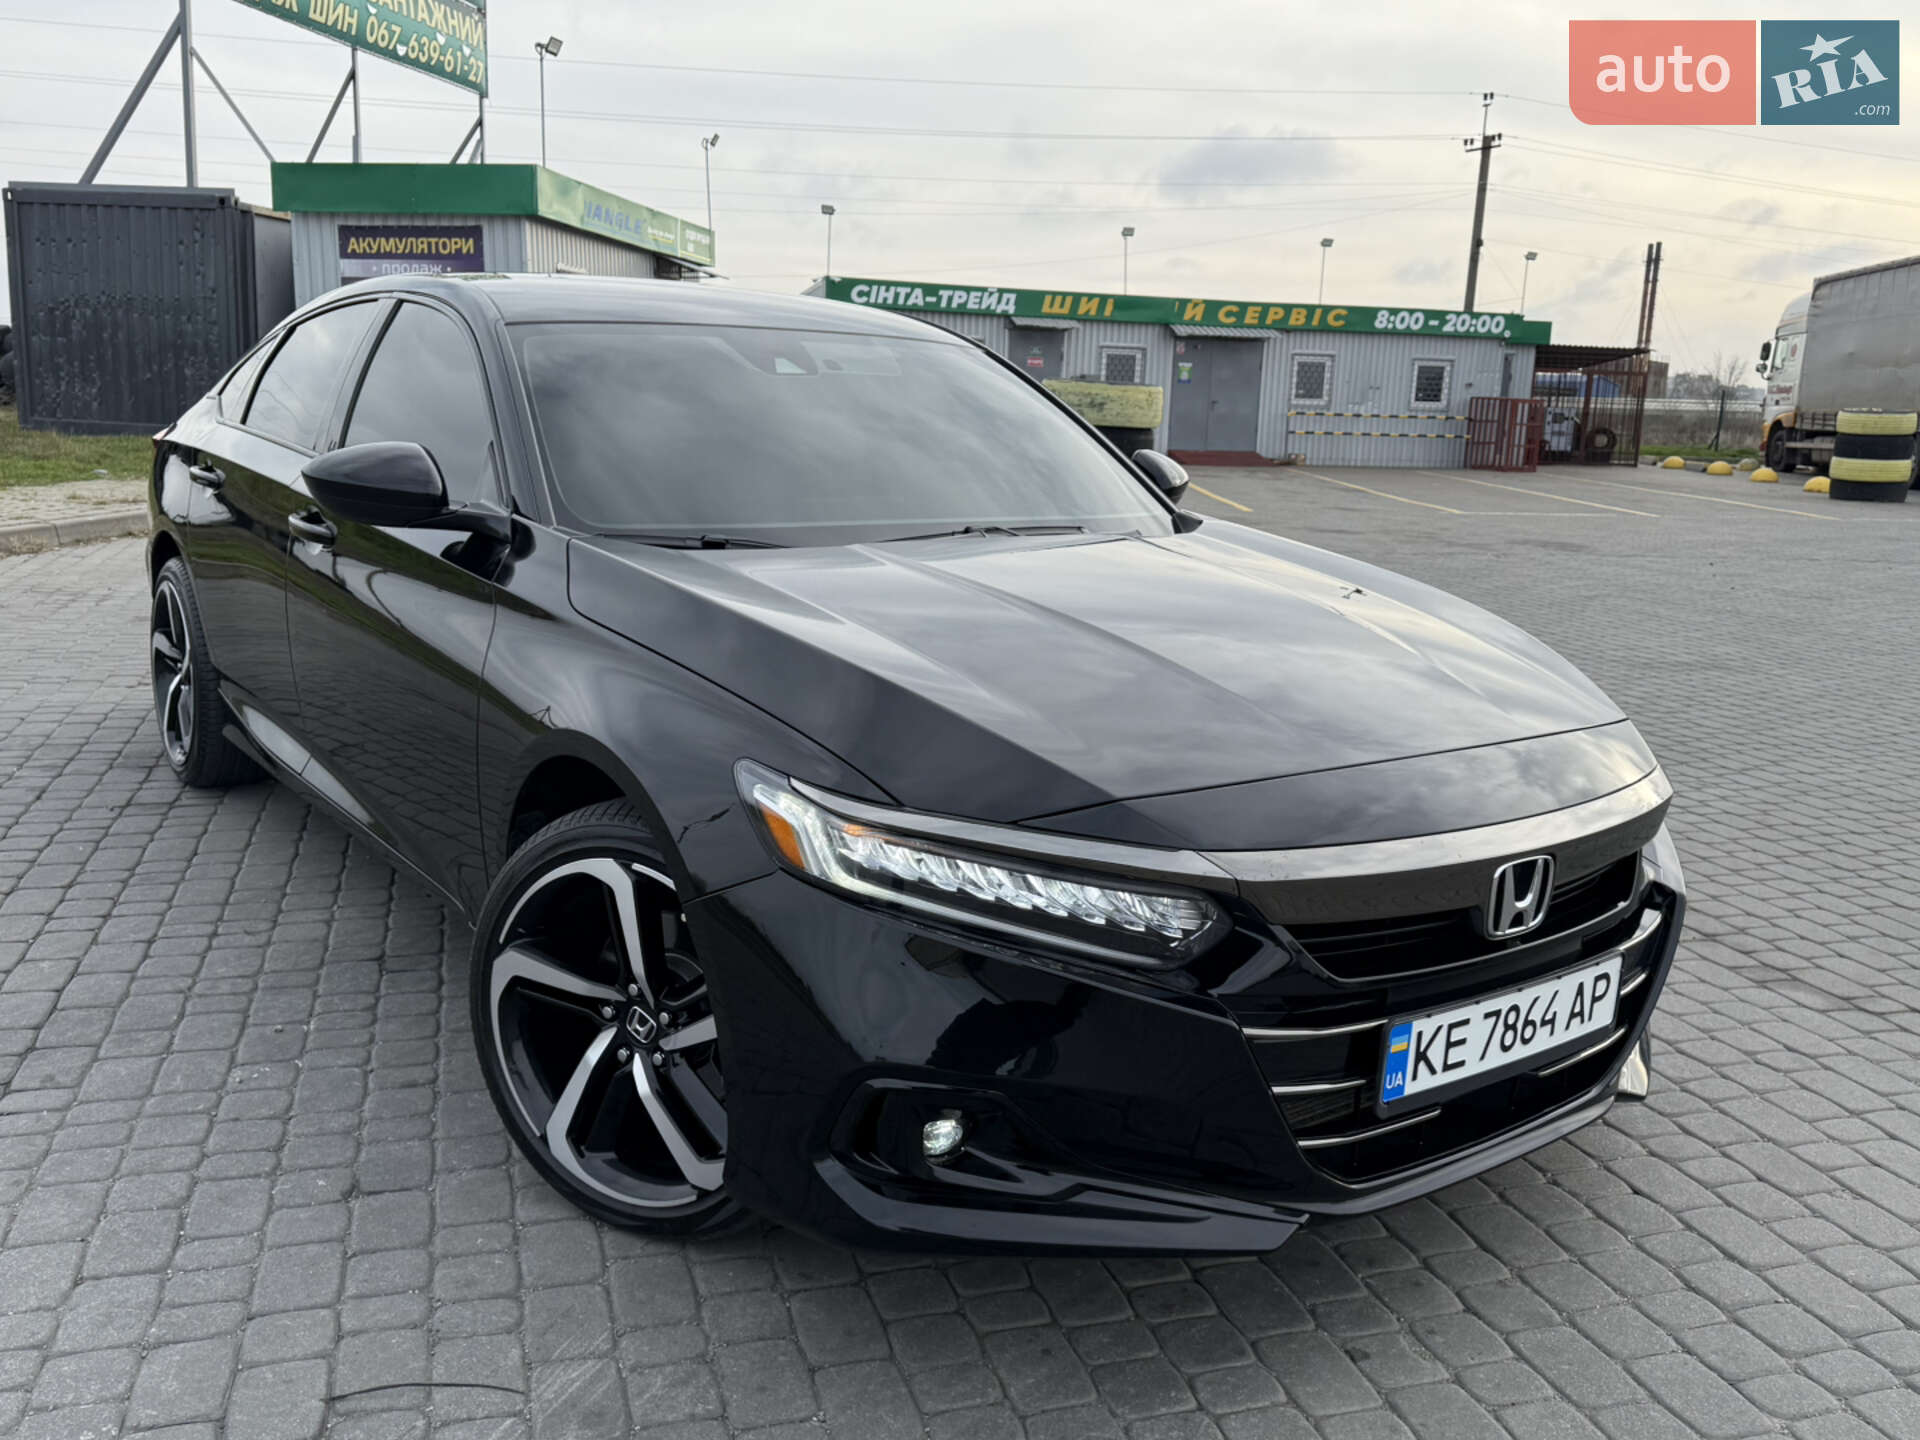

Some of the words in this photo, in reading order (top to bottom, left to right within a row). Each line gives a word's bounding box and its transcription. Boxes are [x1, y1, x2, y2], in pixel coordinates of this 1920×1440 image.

[308, 0, 358, 36] ШИН
[366, 15, 401, 50] 067
[407, 32, 483, 84] 639-61-27
[347, 237, 475, 254] АКУМУЛЯТОРИ
[850, 284, 1017, 314] СІНТА-ТРЕЙД
[1217, 305, 1348, 327] СЕРВІС
[1374, 309, 1424, 330] 8:00
[1411, 1018, 1471, 1081] KE
[1479, 990, 1559, 1062] 7864
[1565, 971, 1612, 1030] AP
[1386, 1071, 1404, 1089] UA
